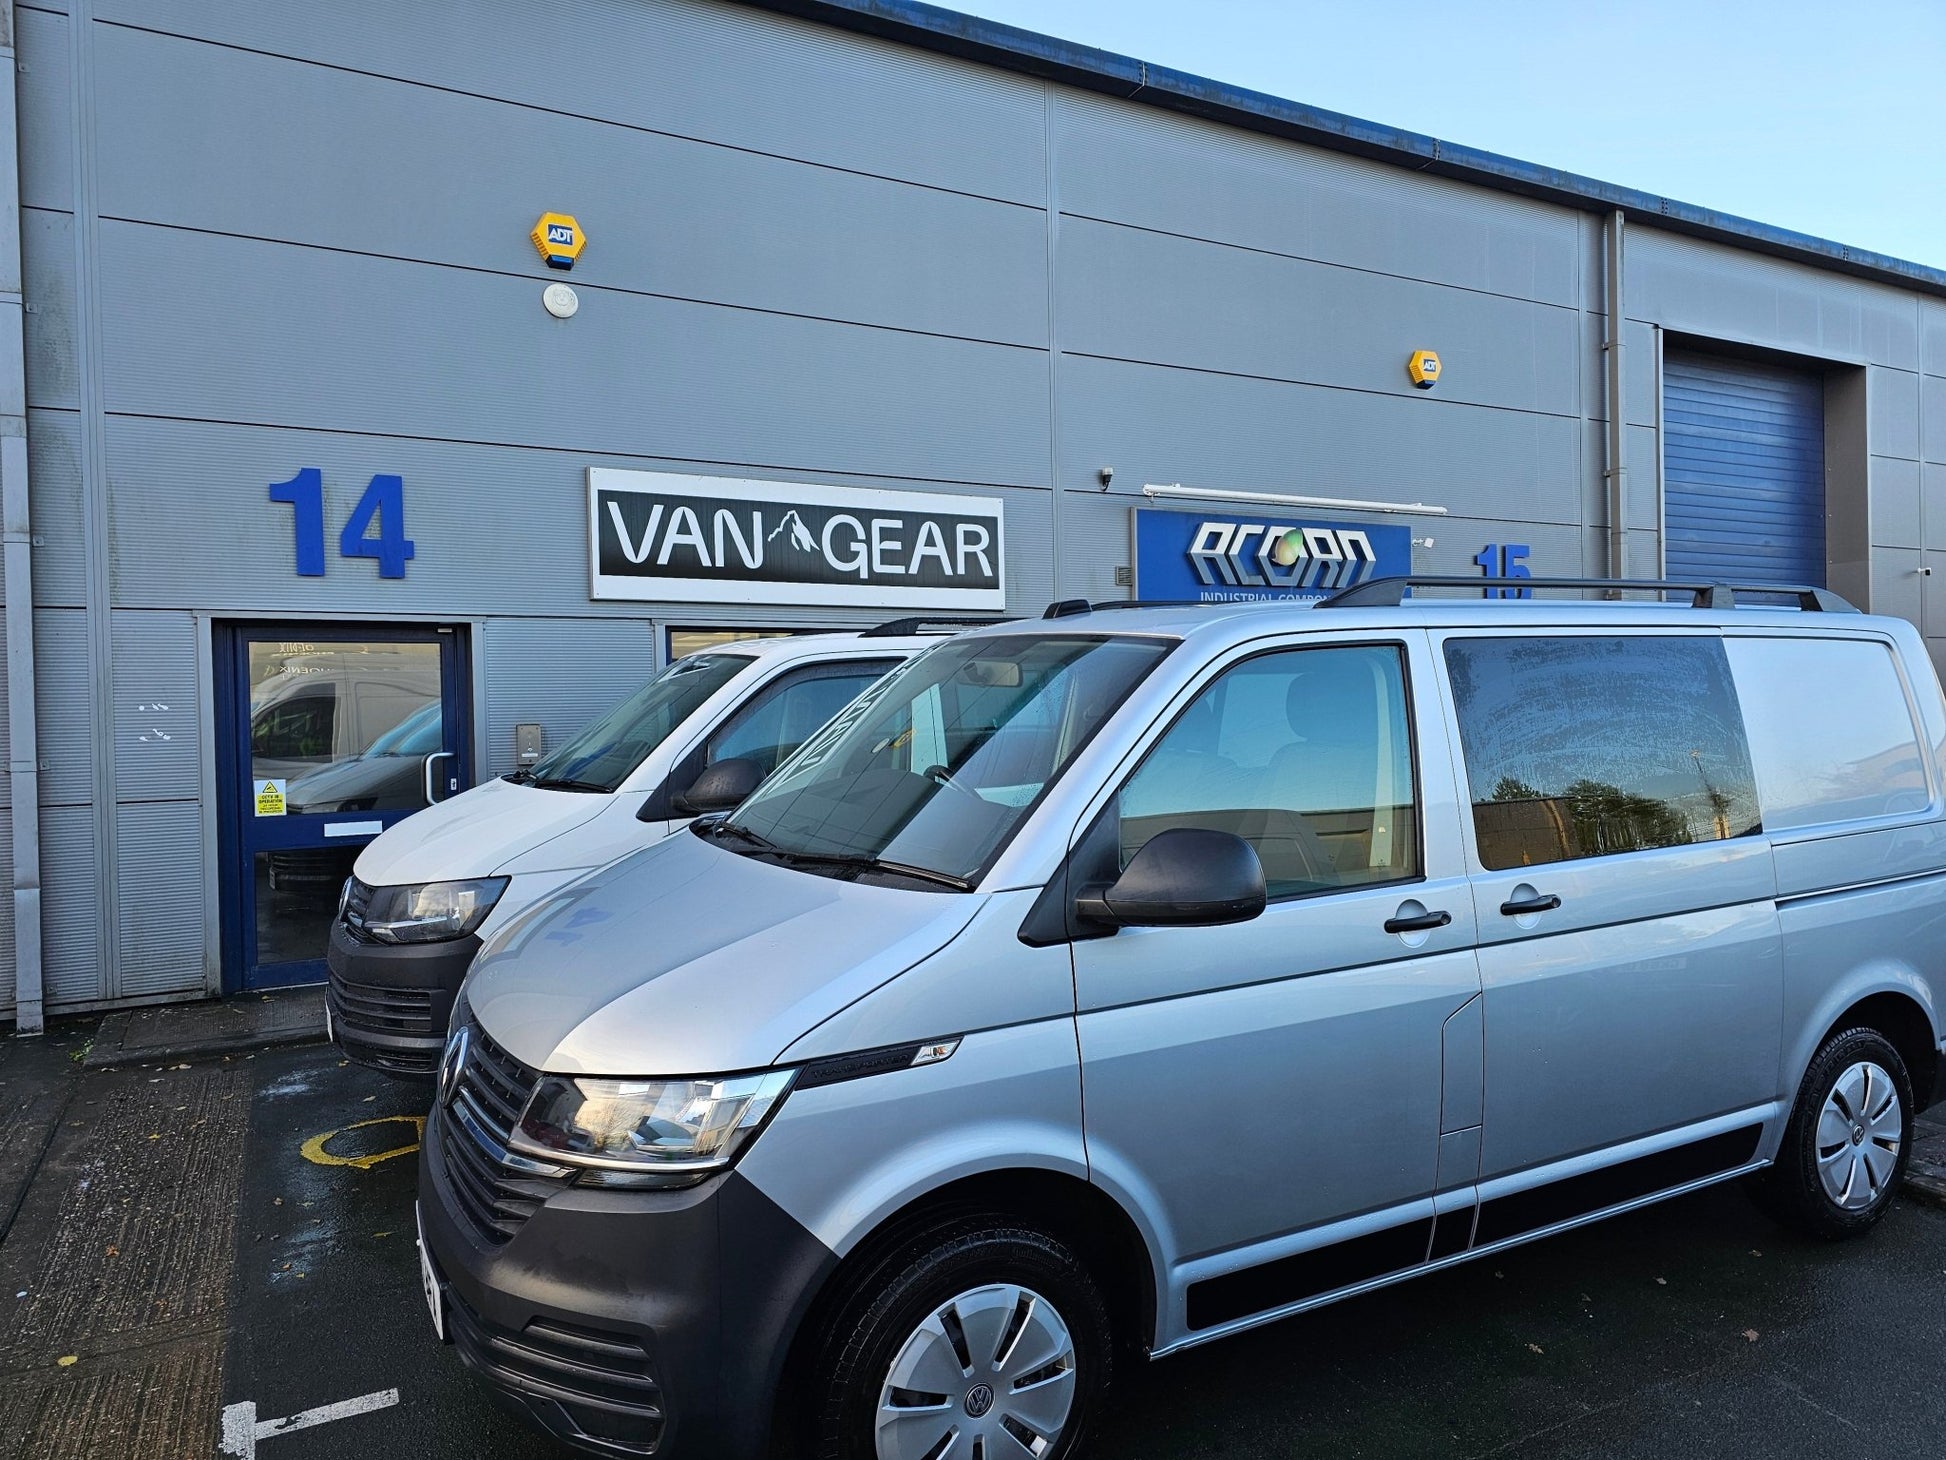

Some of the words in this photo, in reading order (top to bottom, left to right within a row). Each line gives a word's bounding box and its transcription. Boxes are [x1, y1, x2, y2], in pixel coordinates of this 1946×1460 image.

[549, 227, 573, 243] ADT
[269, 467, 414, 578] 14
[606, 501, 763, 569] VAN
[821, 514, 993, 580] GEAR
[1188, 521, 1377, 588] ACORN
[1475, 543, 1533, 599] 15
